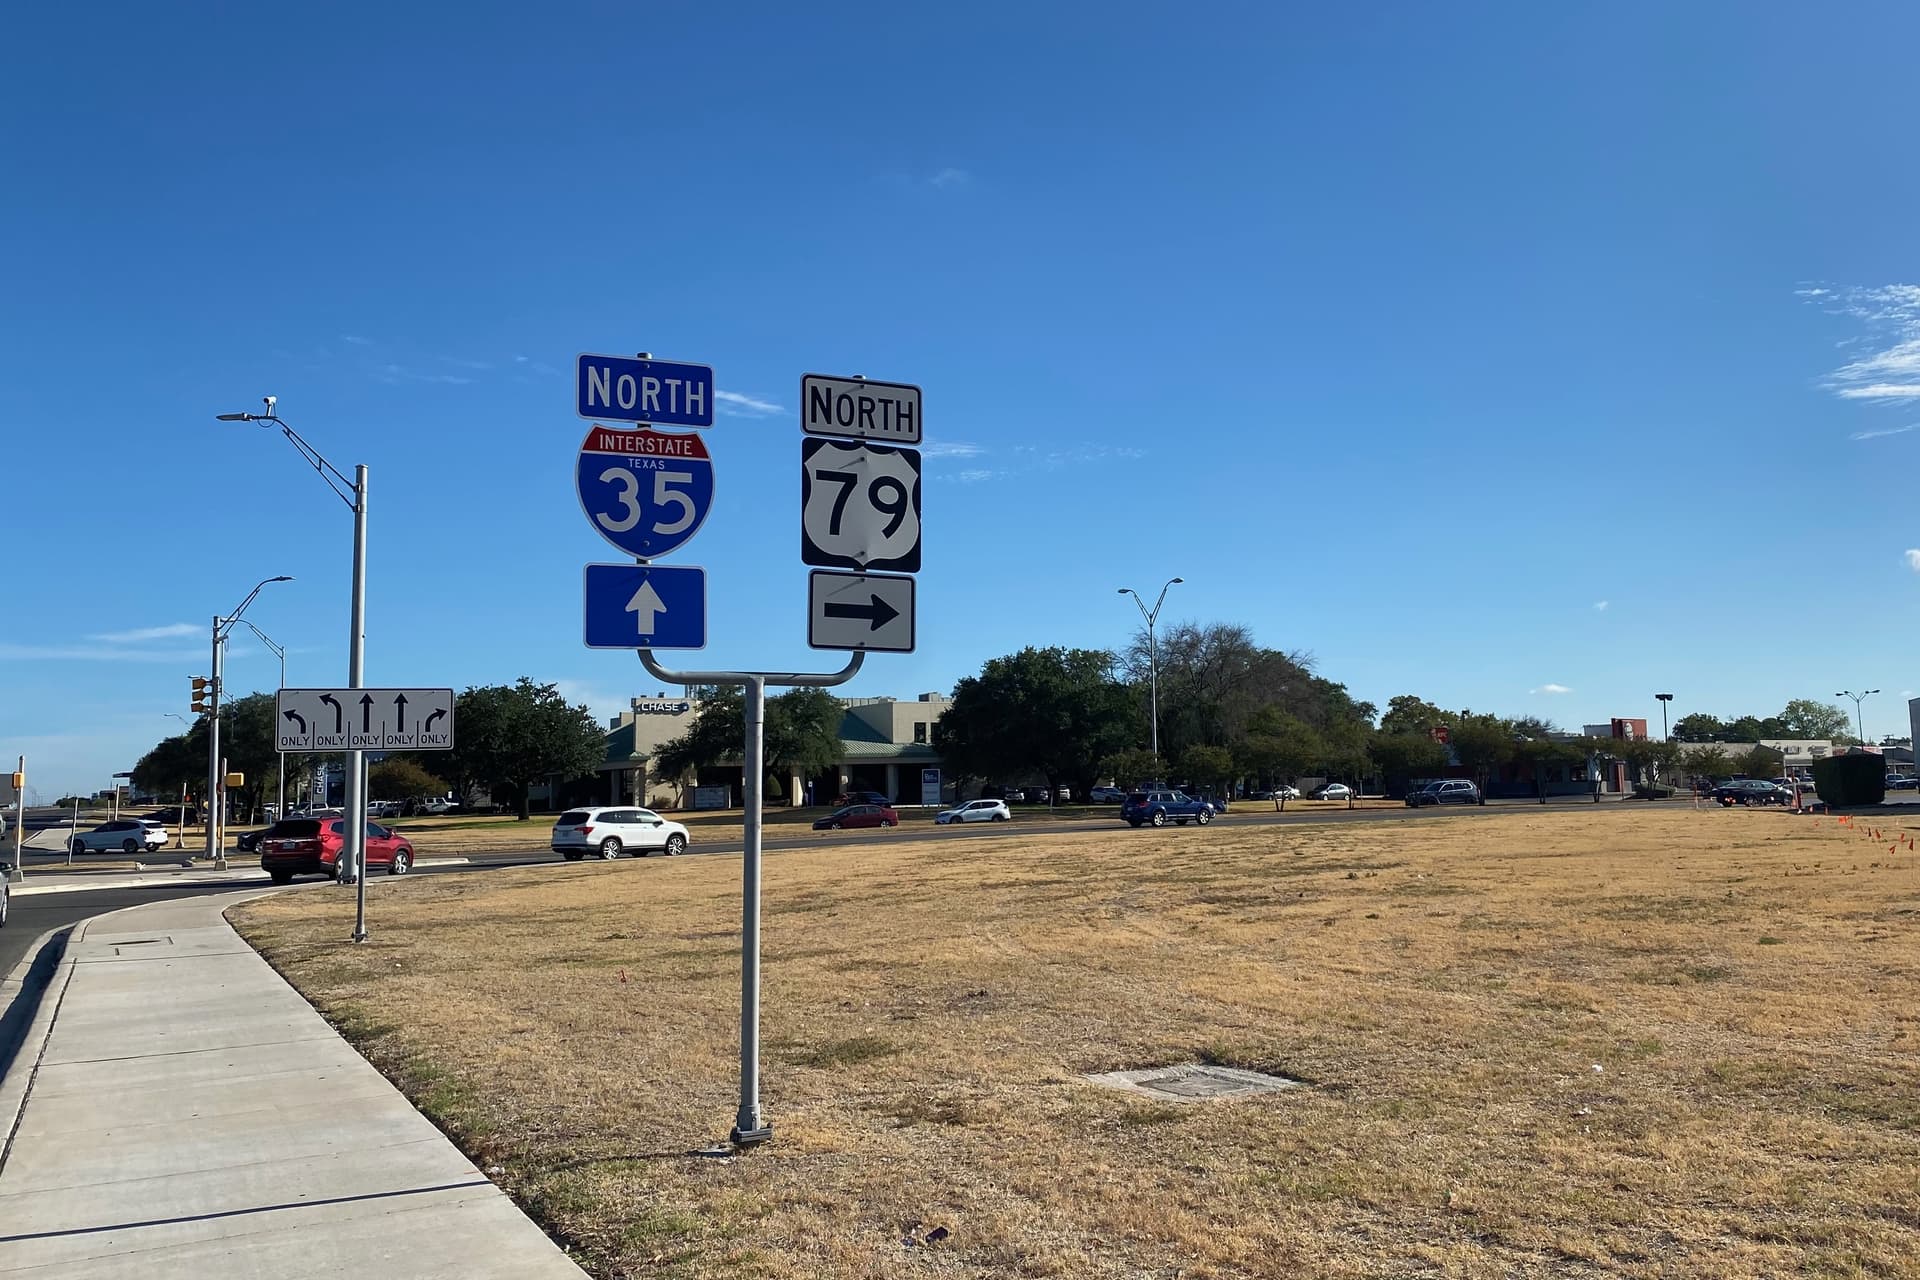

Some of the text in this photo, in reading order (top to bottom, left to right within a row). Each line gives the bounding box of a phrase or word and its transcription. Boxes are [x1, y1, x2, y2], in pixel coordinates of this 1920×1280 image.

[587, 366, 705, 416] NORTH
[810, 386, 913, 433] NORTH
[599, 434, 692, 456] INTERSTATE
[628, 458, 665, 470] TEXAS
[596, 467, 696, 535] 35
[816, 469, 908, 540] 79
[641, 703, 679, 711] CHASE
[281, 734, 448, 746] ONLY ONLY ONLY ONLY ONLY
[316, 765, 325, 794] CHASE
